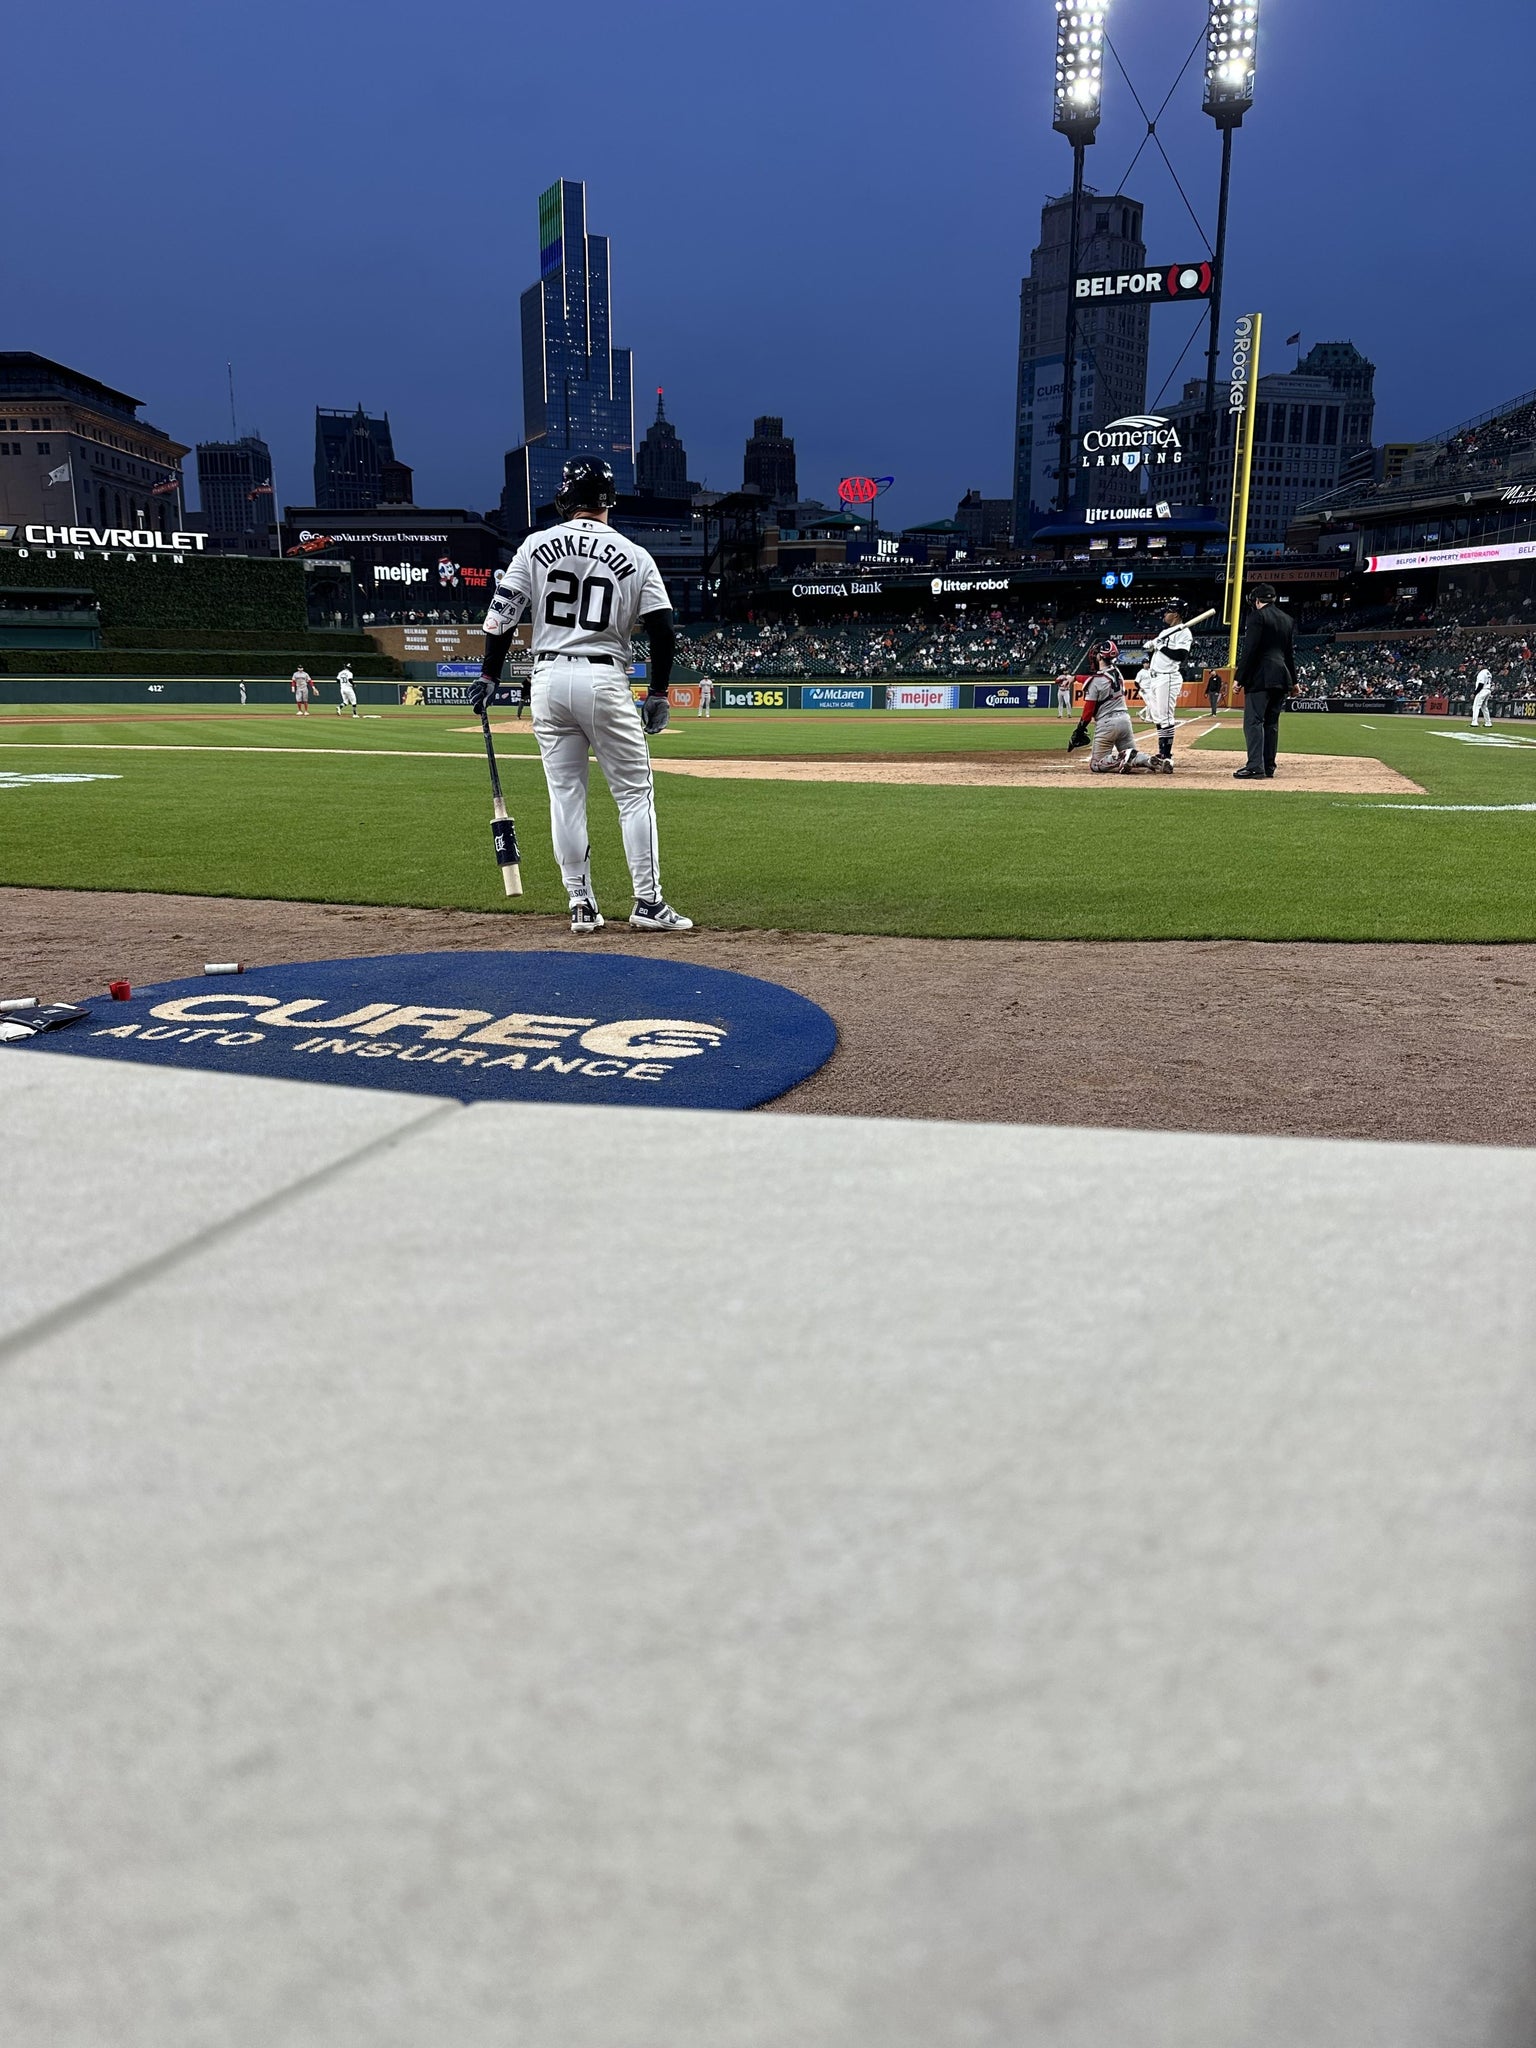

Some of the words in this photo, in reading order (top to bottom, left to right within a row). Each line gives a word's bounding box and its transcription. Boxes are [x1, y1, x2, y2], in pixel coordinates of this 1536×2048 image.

[1075, 272, 1162, 298] BELFOR
[1082, 451, 1182, 472] LANDING
[843, 478, 874, 498] AAA
[1085, 508, 1109, 524] Lite
[1110, 508, 1153, 520] LOUNGE
[25, 525, 208, 550] CHEVROLET
[342, 533, 371, 542] VALLEY
[372, 533, 397, 542] STATE
[397, 533, 448, 542] UNIVERSITY
[877, 539, 900, 556] Lite
[955, 550, 968, 559] Lite
[18, 549, 184, 564] OUNTAIN
[530, 535, 636, 581] TORKELSON
[1429, 554, 1458, 562] PROPERTY
[1460, 550, 1500, 559] RESTORATION
[374, 562, 429, 586] meijer
[461, 568, 492, 578] BELLE
[1297, 570, 1336, 580] CORNER
[464, 578, 488, 586] TIRE
[851, 582, 882, 594] Bank
[545, 569, 614, 632] 20
[725, 690, 784, 706] bet365
[824, 689, 864, 700] McLaren
[901, 690, 943, 706] meijer
[986, 694, 1020, 707] Corona
[1513, 700, 1536, 717] bet365
[638, 907, 648, 915] 20
[90, 1023, 266, 1047] AUTO
[293, 1036, 675, 1082] INSURANCE
